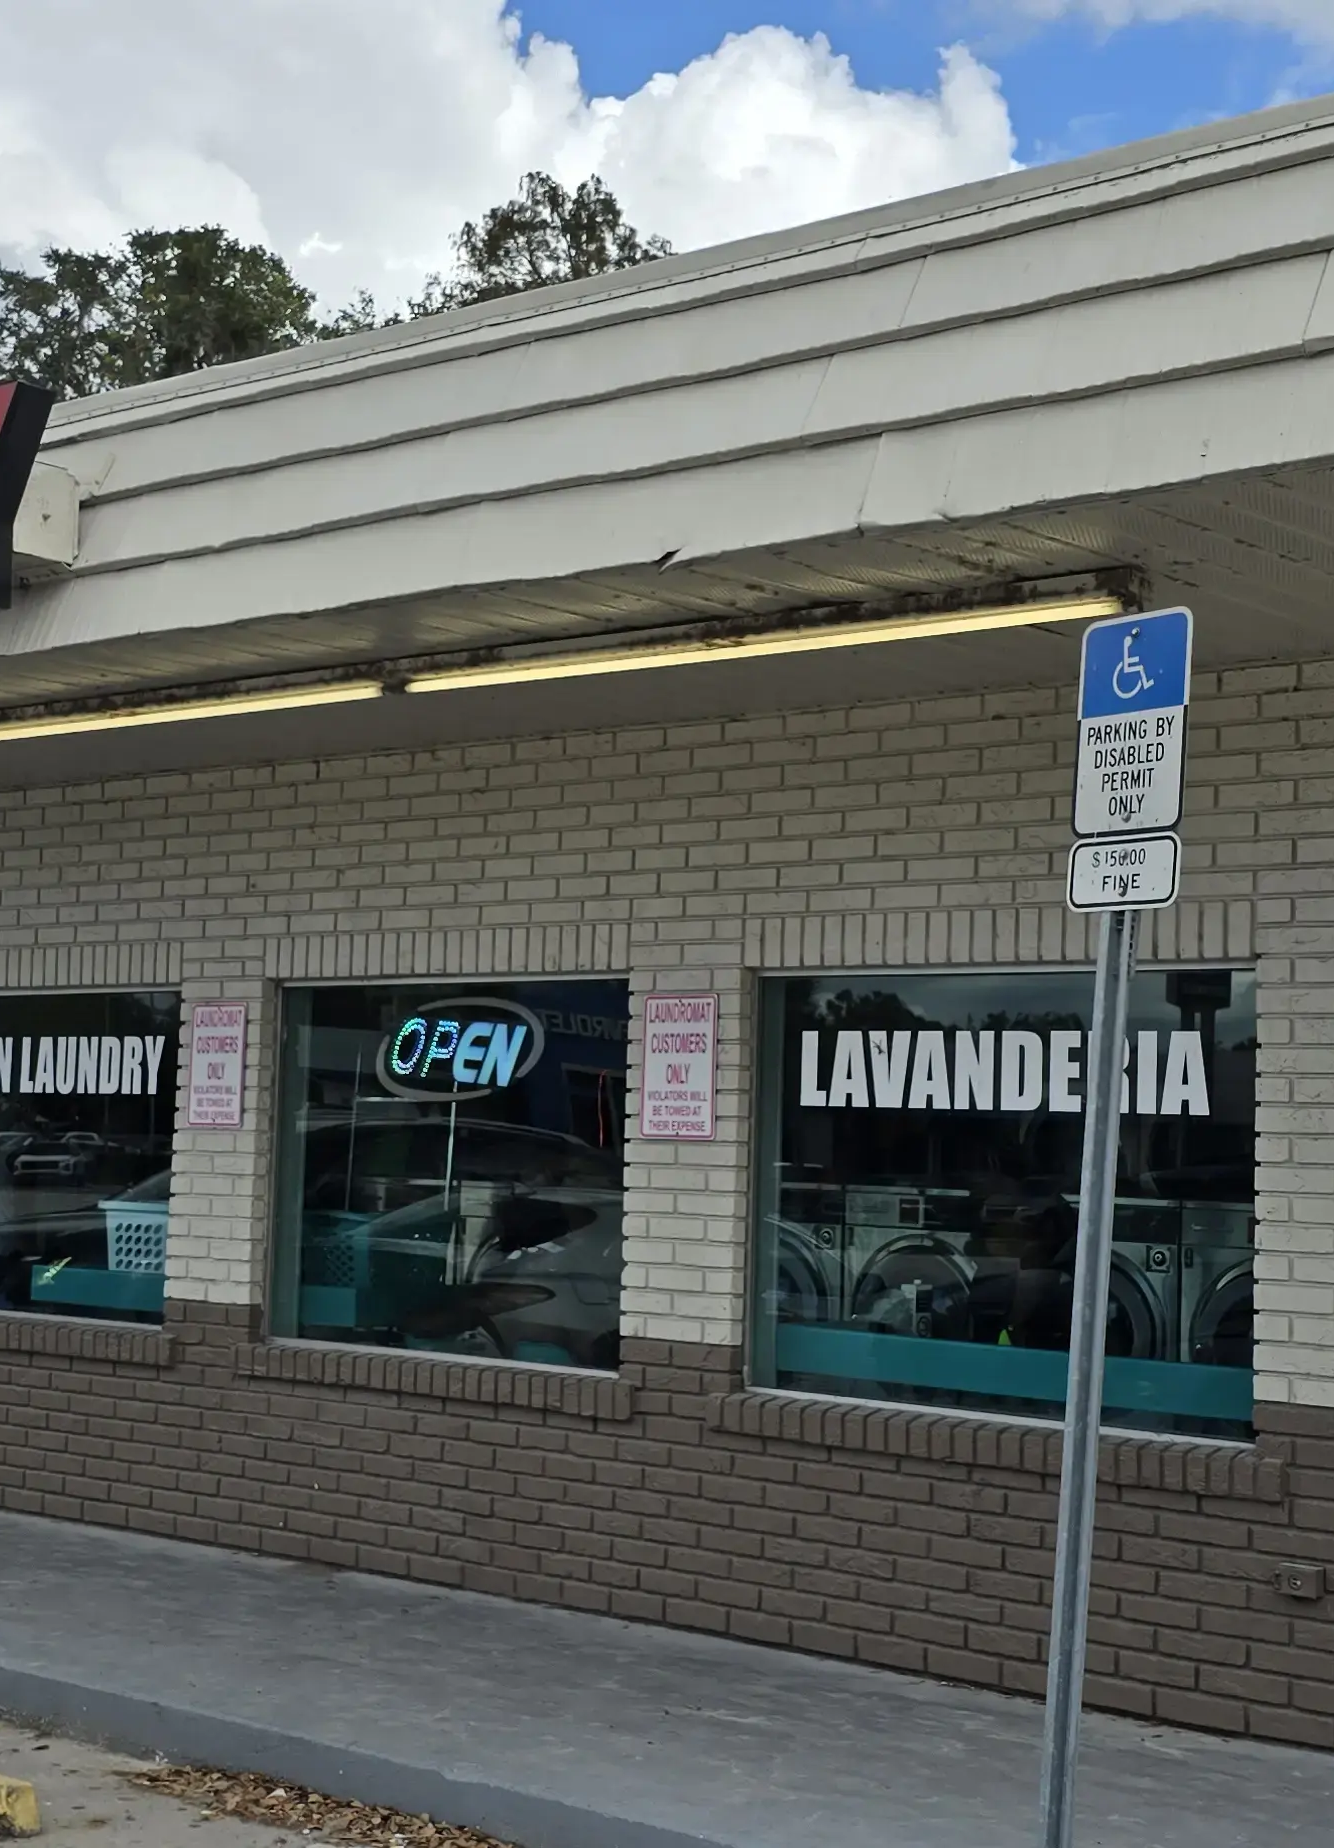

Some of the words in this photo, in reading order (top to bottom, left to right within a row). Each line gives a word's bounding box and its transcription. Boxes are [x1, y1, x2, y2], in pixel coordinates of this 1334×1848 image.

[1087, 718, 1147, 746] PARKING
[1156, 716, 1175, 737] BY
[1094, 742, 1165, 770] DISABLED
[1101, 768, 1154, 792] PERMIT
[1108, 794, 1145, 816] ONLY
[1102, 873, 1141, 892] FINE
[649, 1002, 711, 1023] LAUNDROMAT
[391, 1017, 527, 1087] OPEN
[651, 1033, 707, 1053] CUSTOMERS
[19, 1035, 166, 1095] LAUNDRY
[666, 1063, 690, 1084] ONLY
[648, 1091, 689, 1101] VIOLATORS
[690, 1091, 708, 1102] WILL
[652, 1106, 663, 1116] BE
[665, 1106, 690, 1116] TOWED
[692, 1106, 702, 1116] AT
[649, 1120, 670, 1131] THEIR
[671, 1121, 706, 1132] EXPENSE
